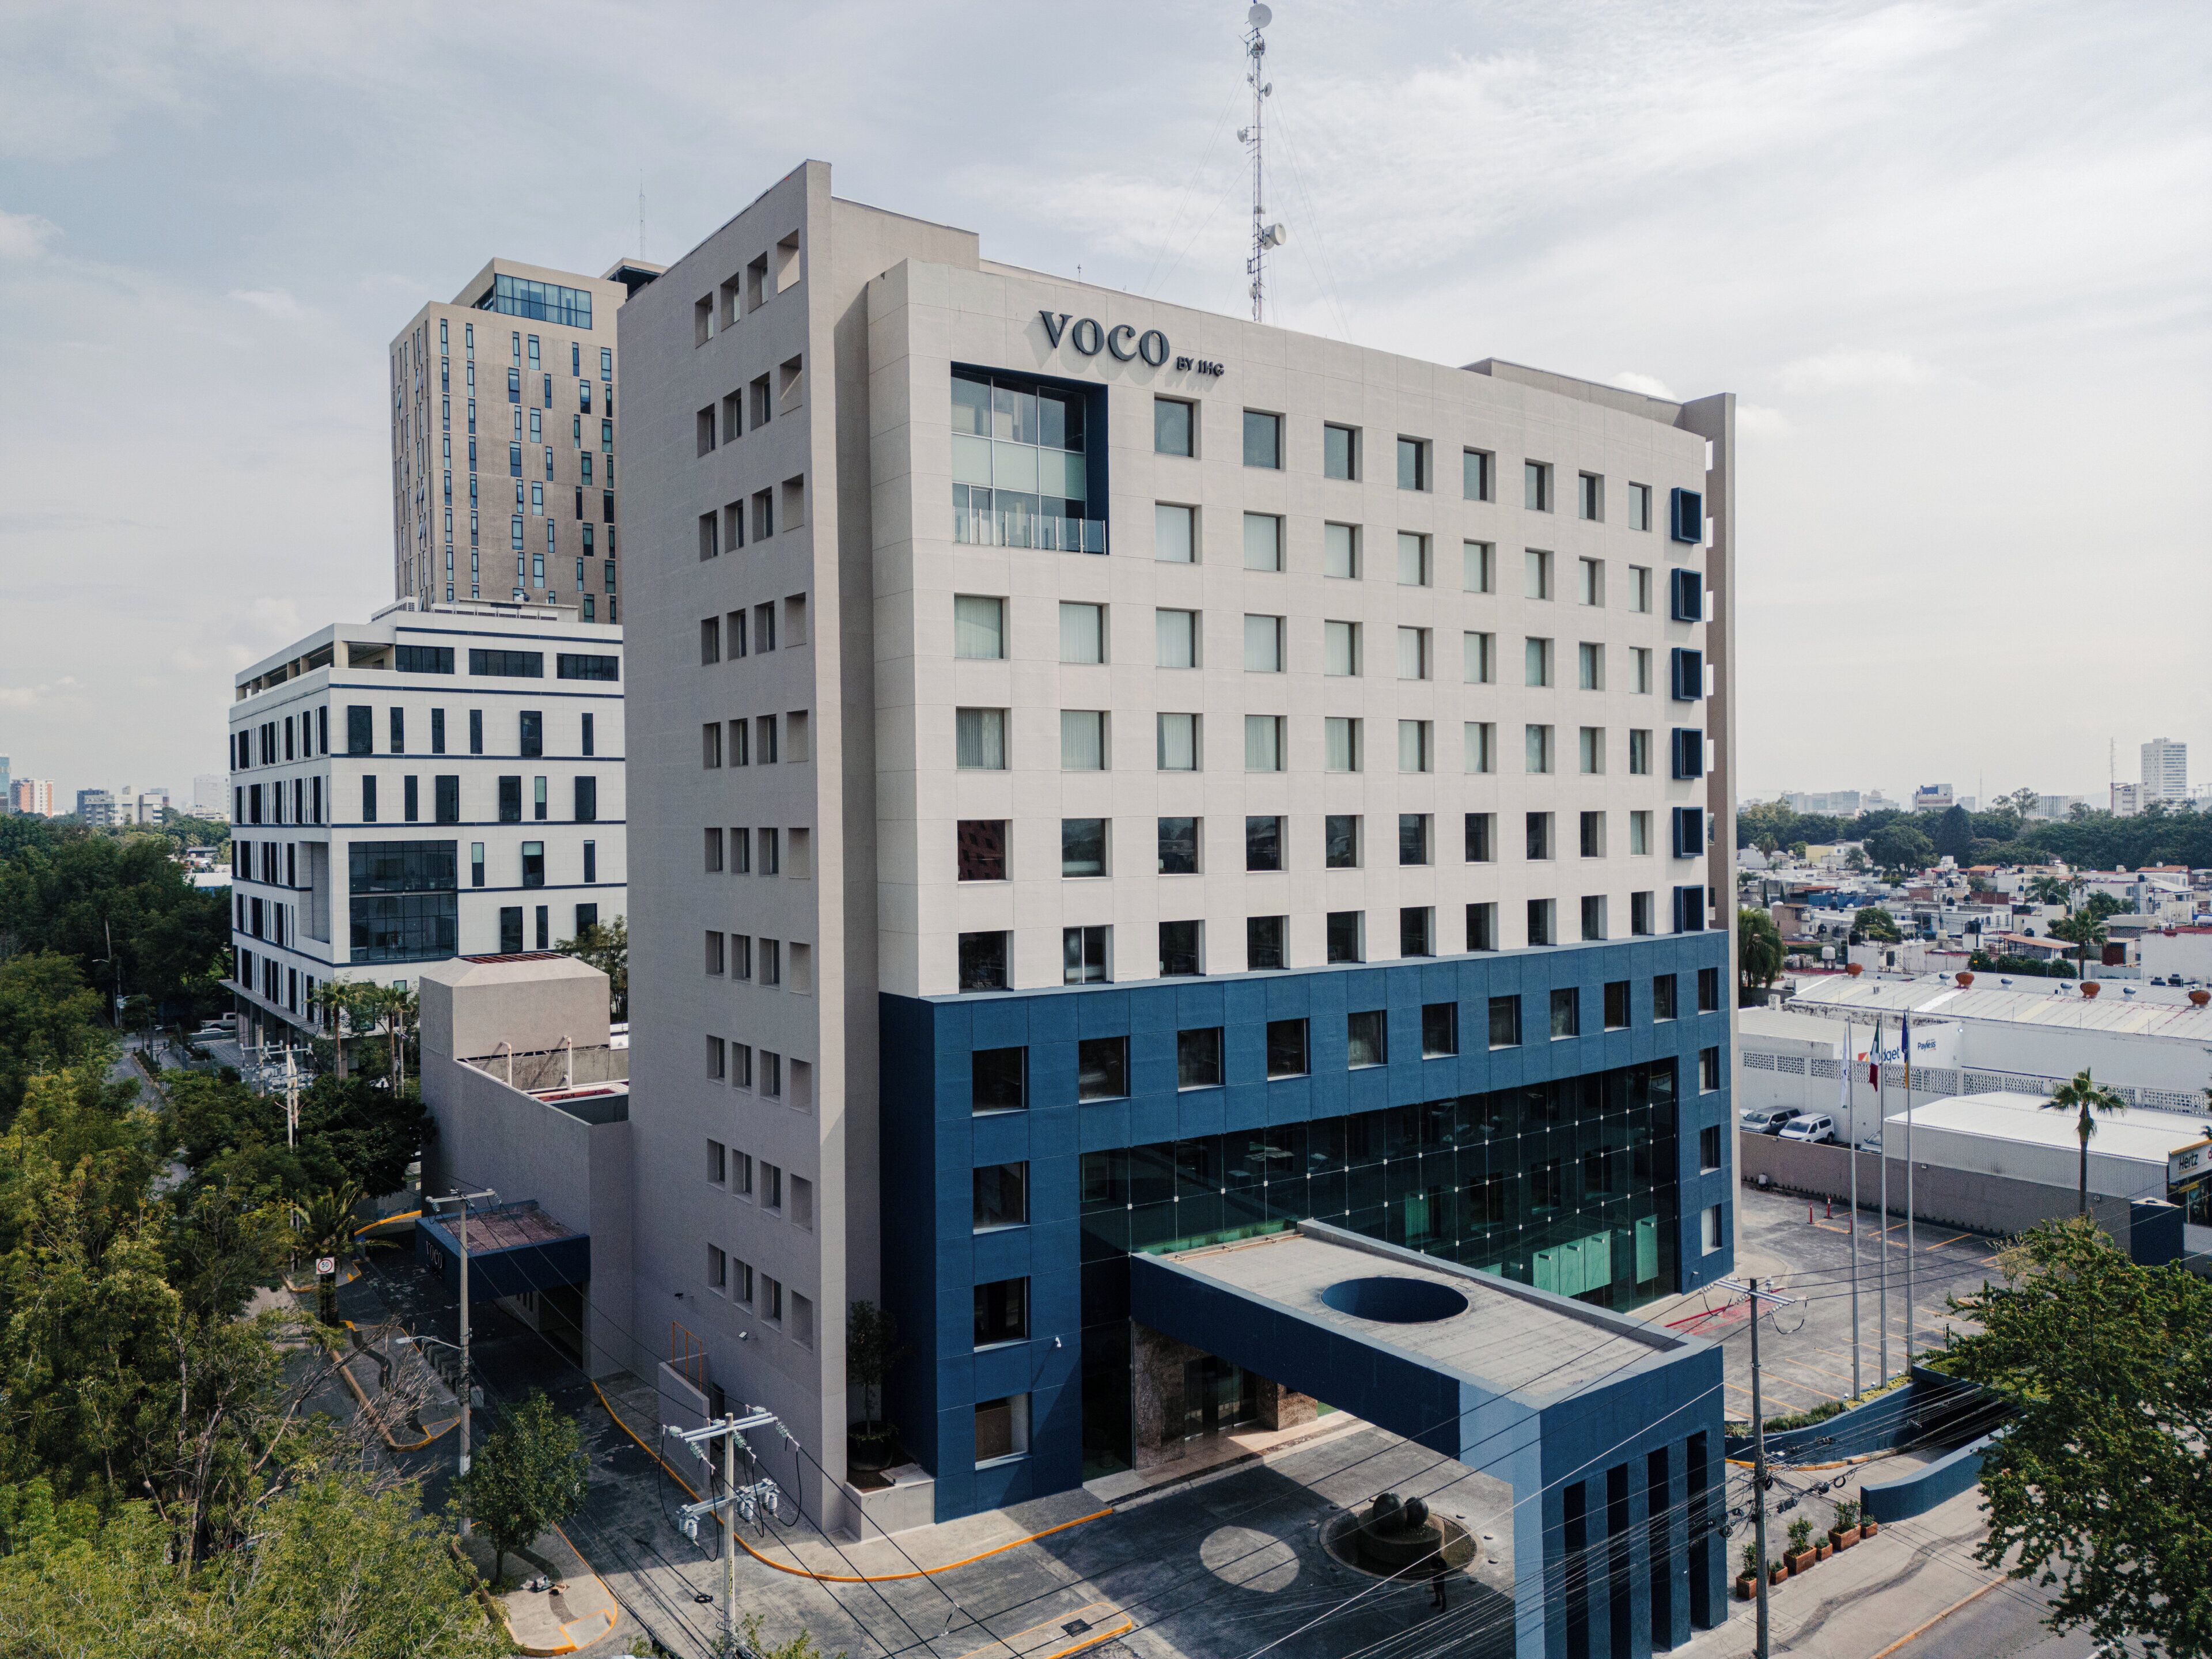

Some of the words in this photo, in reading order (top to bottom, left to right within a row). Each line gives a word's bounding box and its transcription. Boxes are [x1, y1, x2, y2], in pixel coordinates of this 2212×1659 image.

[1039, 310, 1170, 366] VOCO
[1177, 356, 1194, 370] BY
[1198, 359, 1224, 376] IHG
[1918, 1040, 1936, 1051] Payless
[2179, 1153, 2198, 1170] Hertz
[426, 1240, 442, 1269] VOCO
